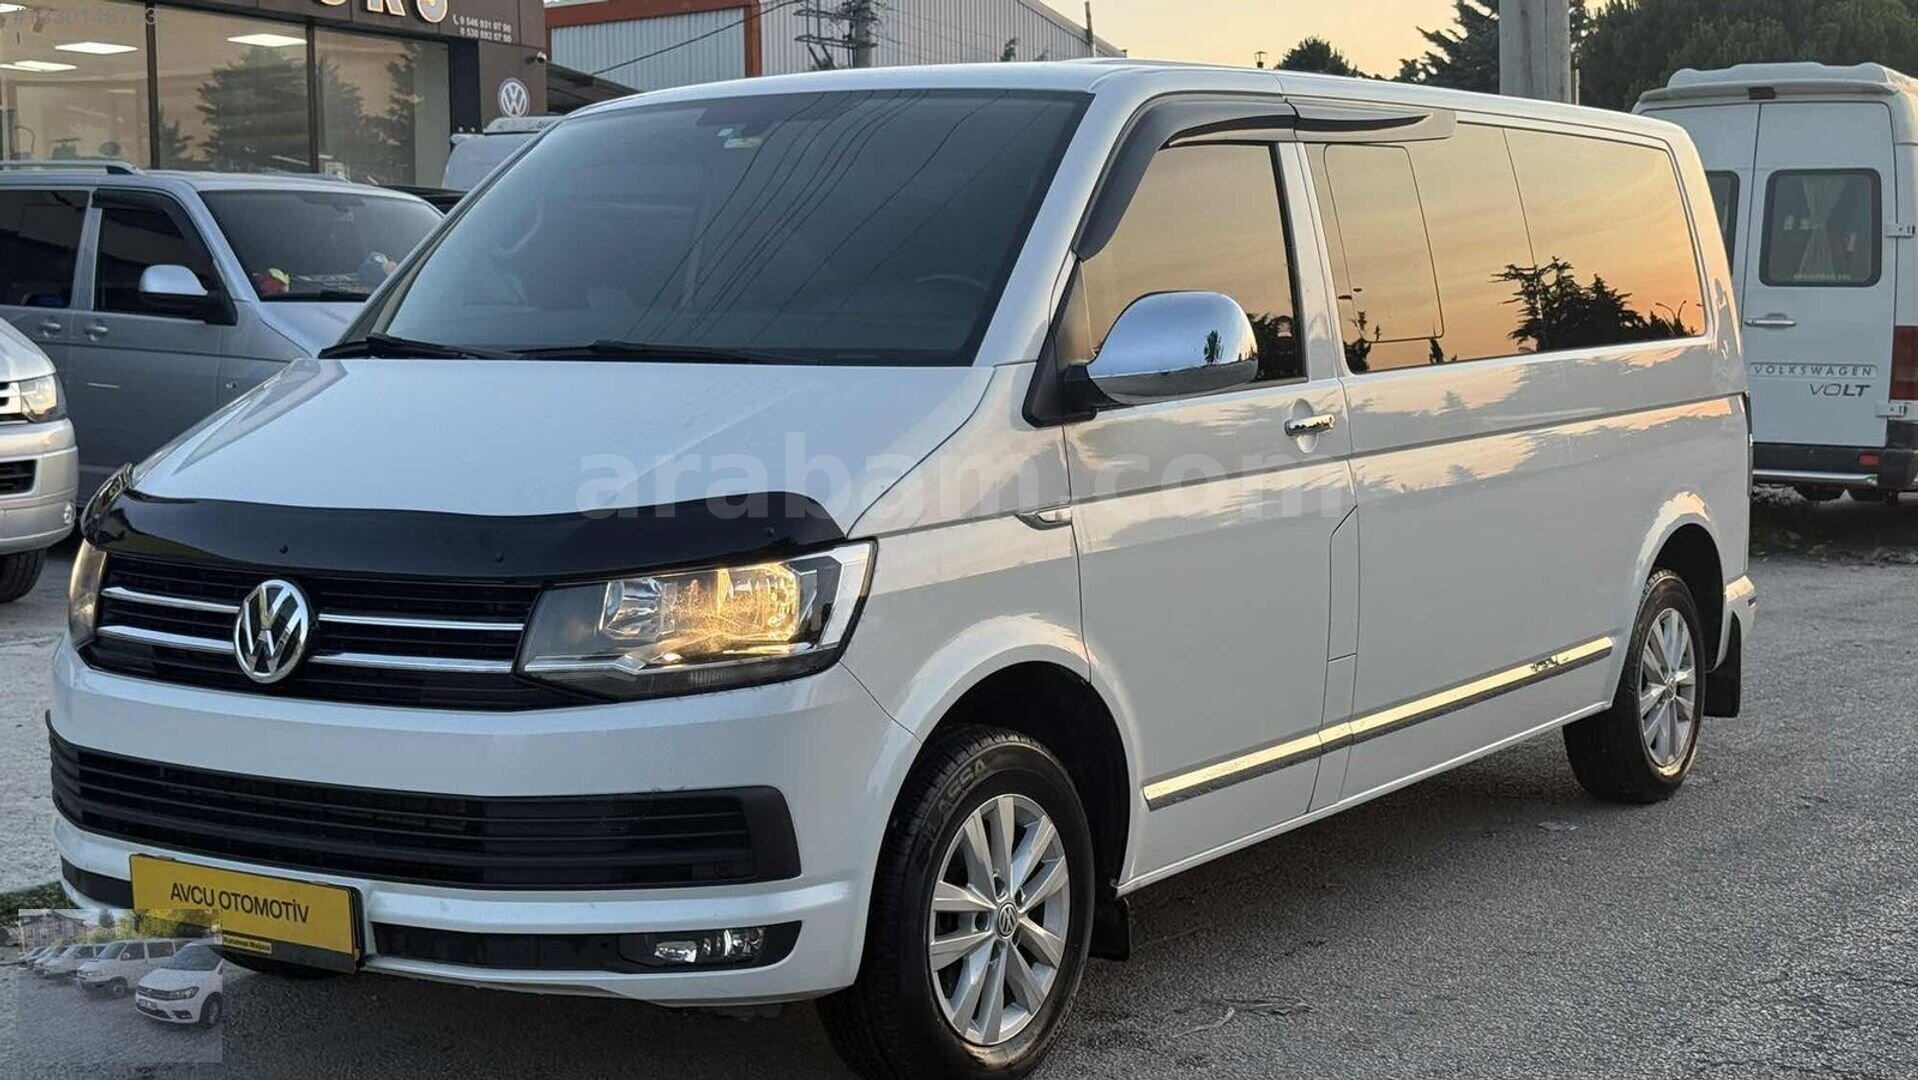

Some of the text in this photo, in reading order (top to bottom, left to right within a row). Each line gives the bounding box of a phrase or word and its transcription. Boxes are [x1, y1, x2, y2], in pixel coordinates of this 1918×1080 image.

[1753, 365, 1872, 377] VOLKSWAGEN
[1809, 383, 1871, 397] VOLT
[170, 882, 215, 907] AVCU
